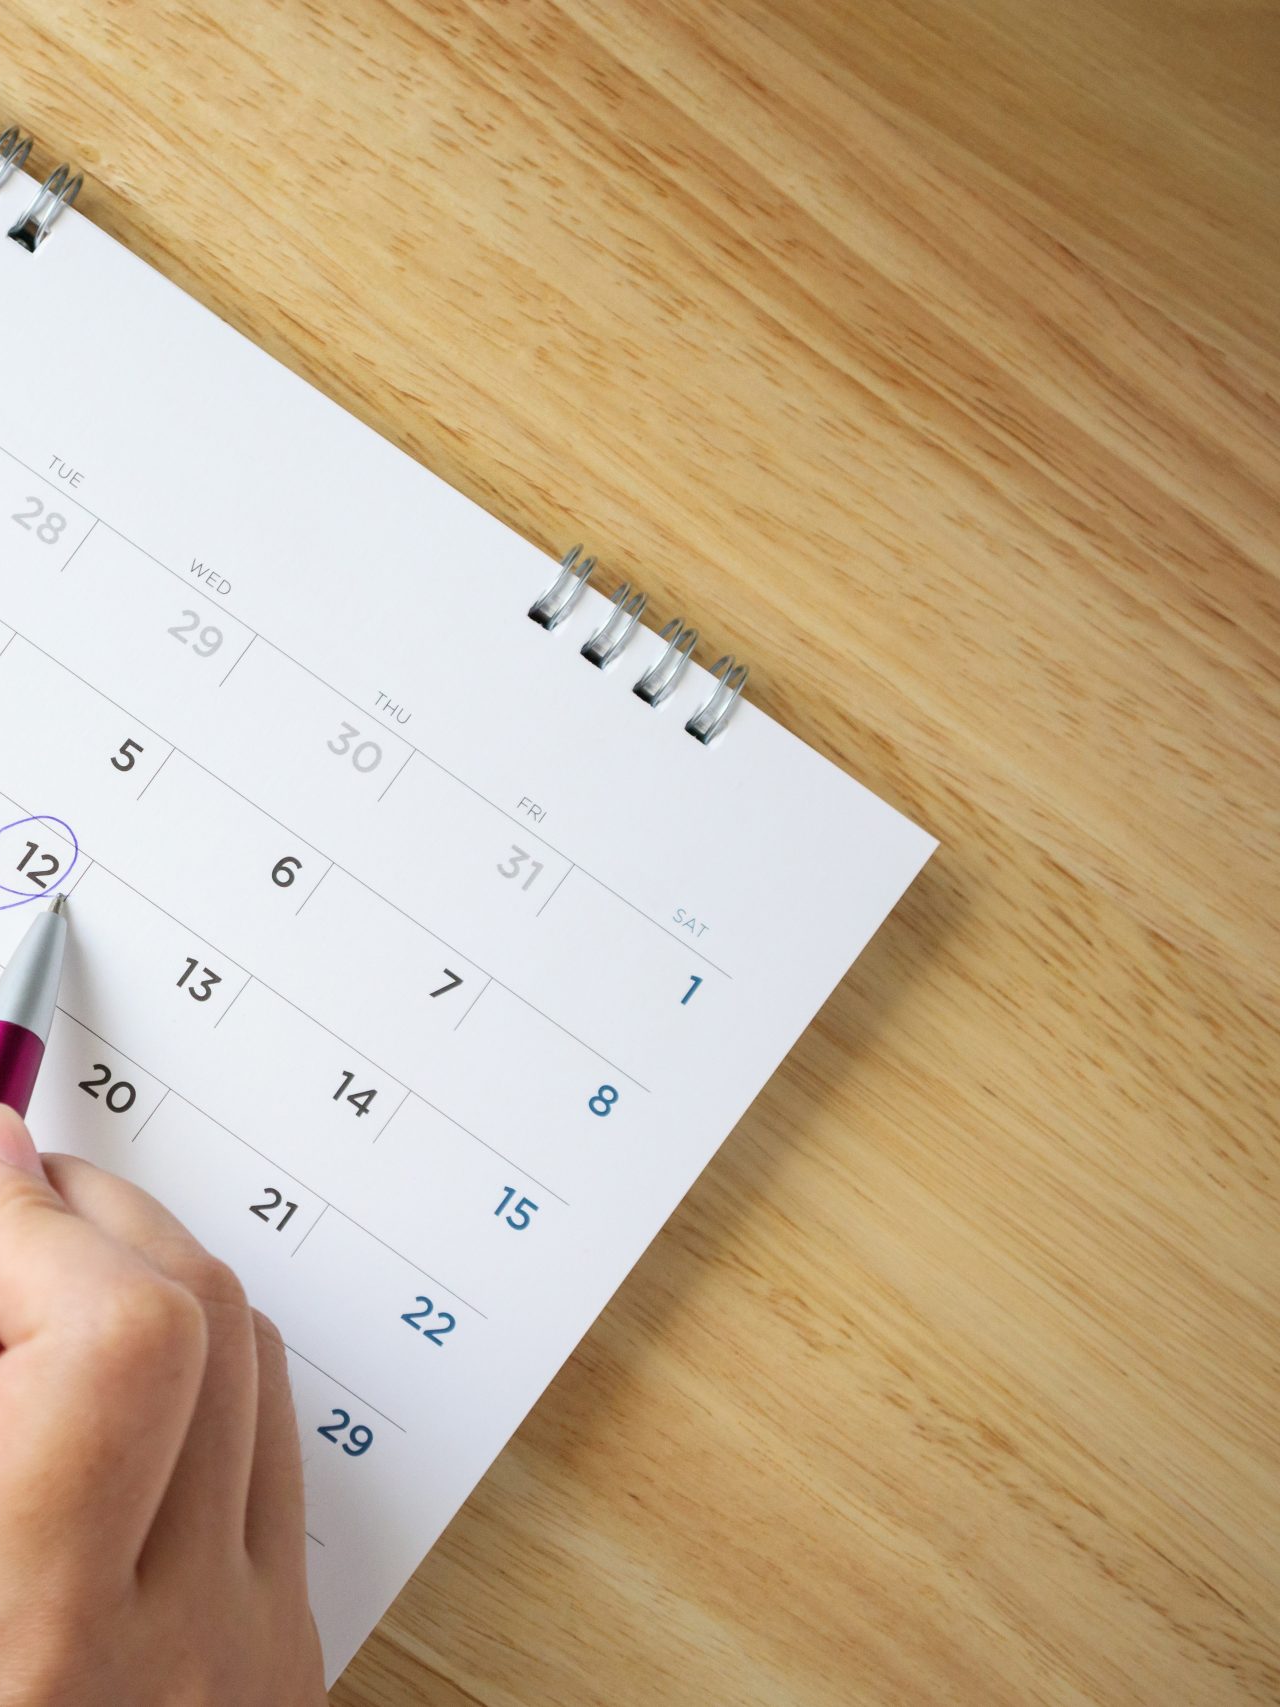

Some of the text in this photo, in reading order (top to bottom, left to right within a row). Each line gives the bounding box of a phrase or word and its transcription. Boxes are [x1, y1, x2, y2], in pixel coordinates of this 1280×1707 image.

[11, 496, 67, 544] 28
[167, 610, 223, 657] 29
[326, 722, 383, 774] 30
[497, 844, 544, 891] 31
[681, 975, 702, 1005] 1
[47, 455, 85, 489] TUE
[188, 558, 233, 596] WED
[372, 691, 412, 725] THU
[516, 797, 549, 824] FRI
[672, 908, 710, 939] SAT
[16, 841, 60, 889] 12
[176, 957, 222, 1001] 13
[333, 1071, 377, 1117] 14
[495, 1186, 538, 1230] 15
[111, 738, 144, 771] 5
[272, 857, 302, 887] 6
[429, 968, 463, 997] 7
[589, 1085, 618, 1117] 8
[78, 1064, 136, 1113] 20
[249, 1188, 298, 1232] 21
[401, 1296, 455, 1347] 22
[317, 1409, 373, 1456] 29
